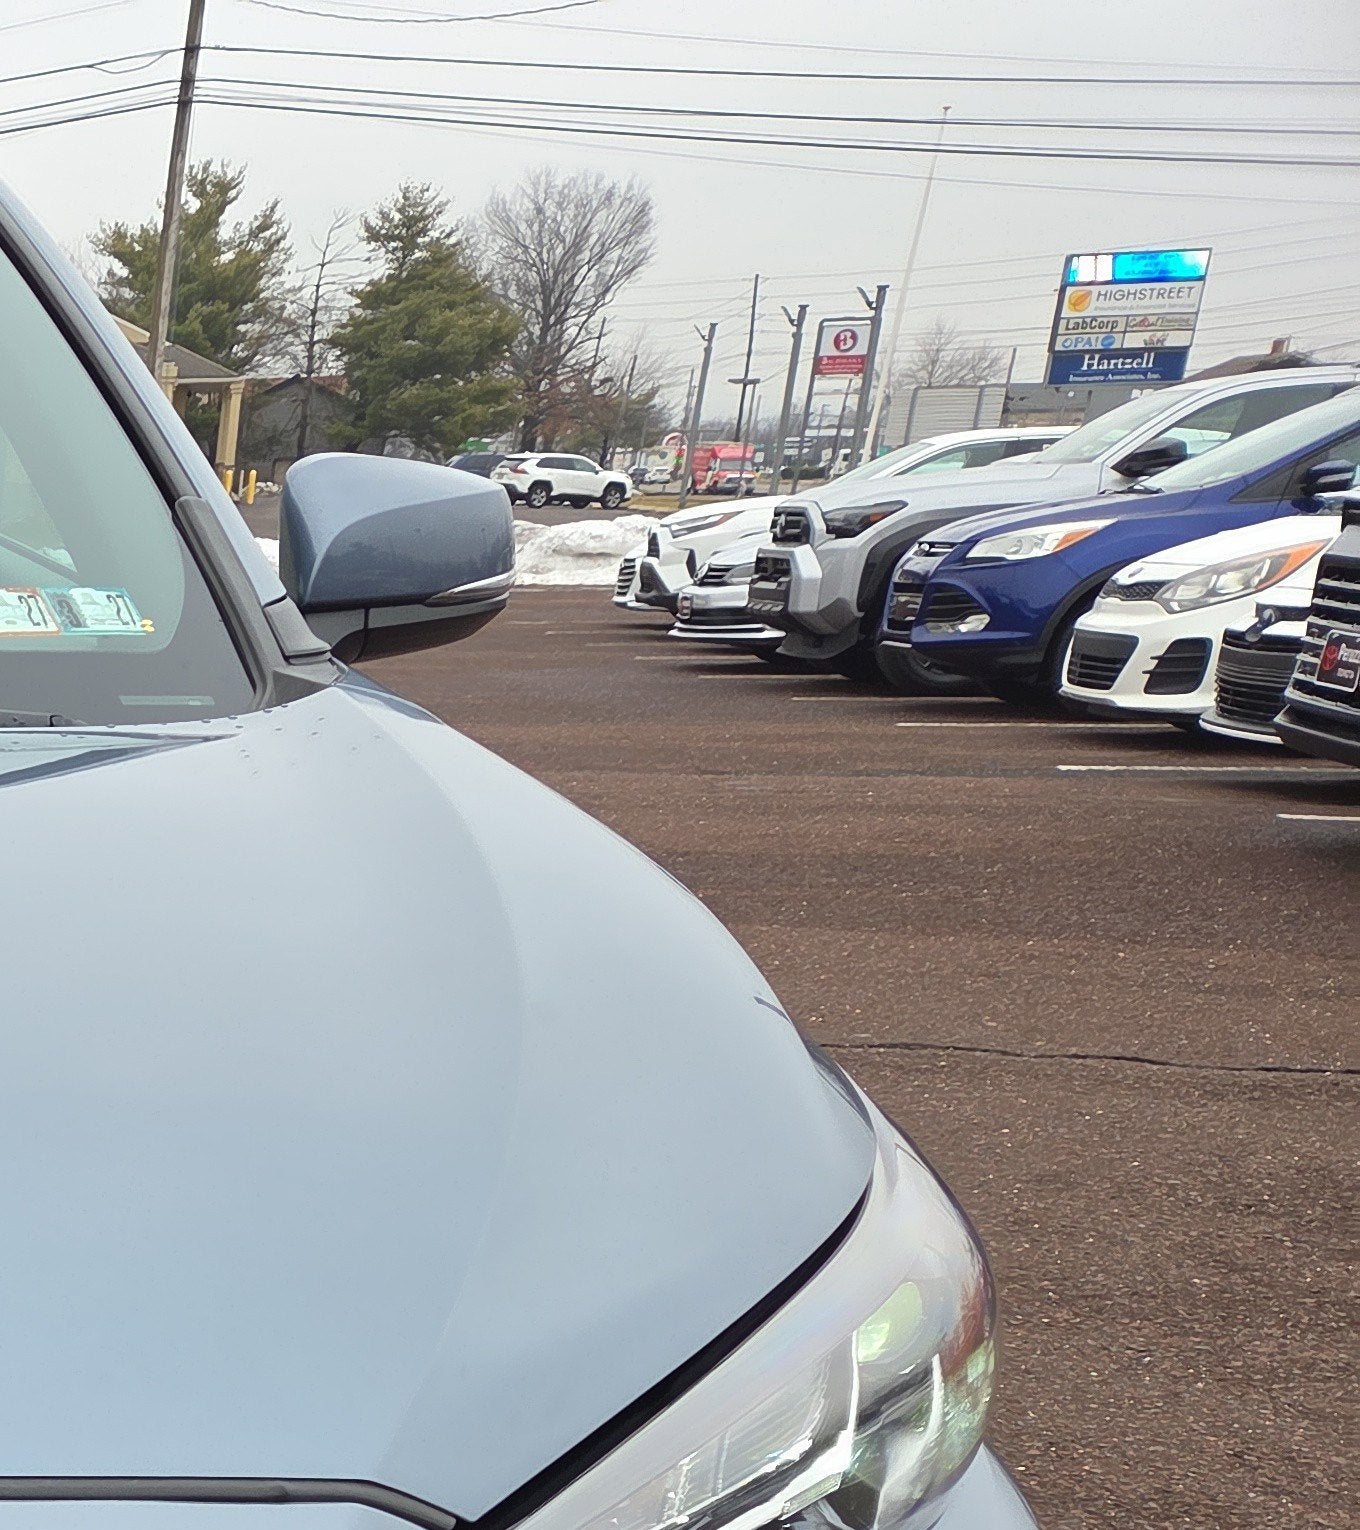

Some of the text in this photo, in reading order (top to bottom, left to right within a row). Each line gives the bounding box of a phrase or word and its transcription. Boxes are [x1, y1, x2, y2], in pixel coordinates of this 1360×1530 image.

[1096, 286, 1196, 302] HIGHSTREET
[1064, 317, 1119, 333] LabCorp
[1080, 351, 1155, 371] Hartzell
[17, 595, 48, 628] 27
[106, 594, 137, 627] 27
